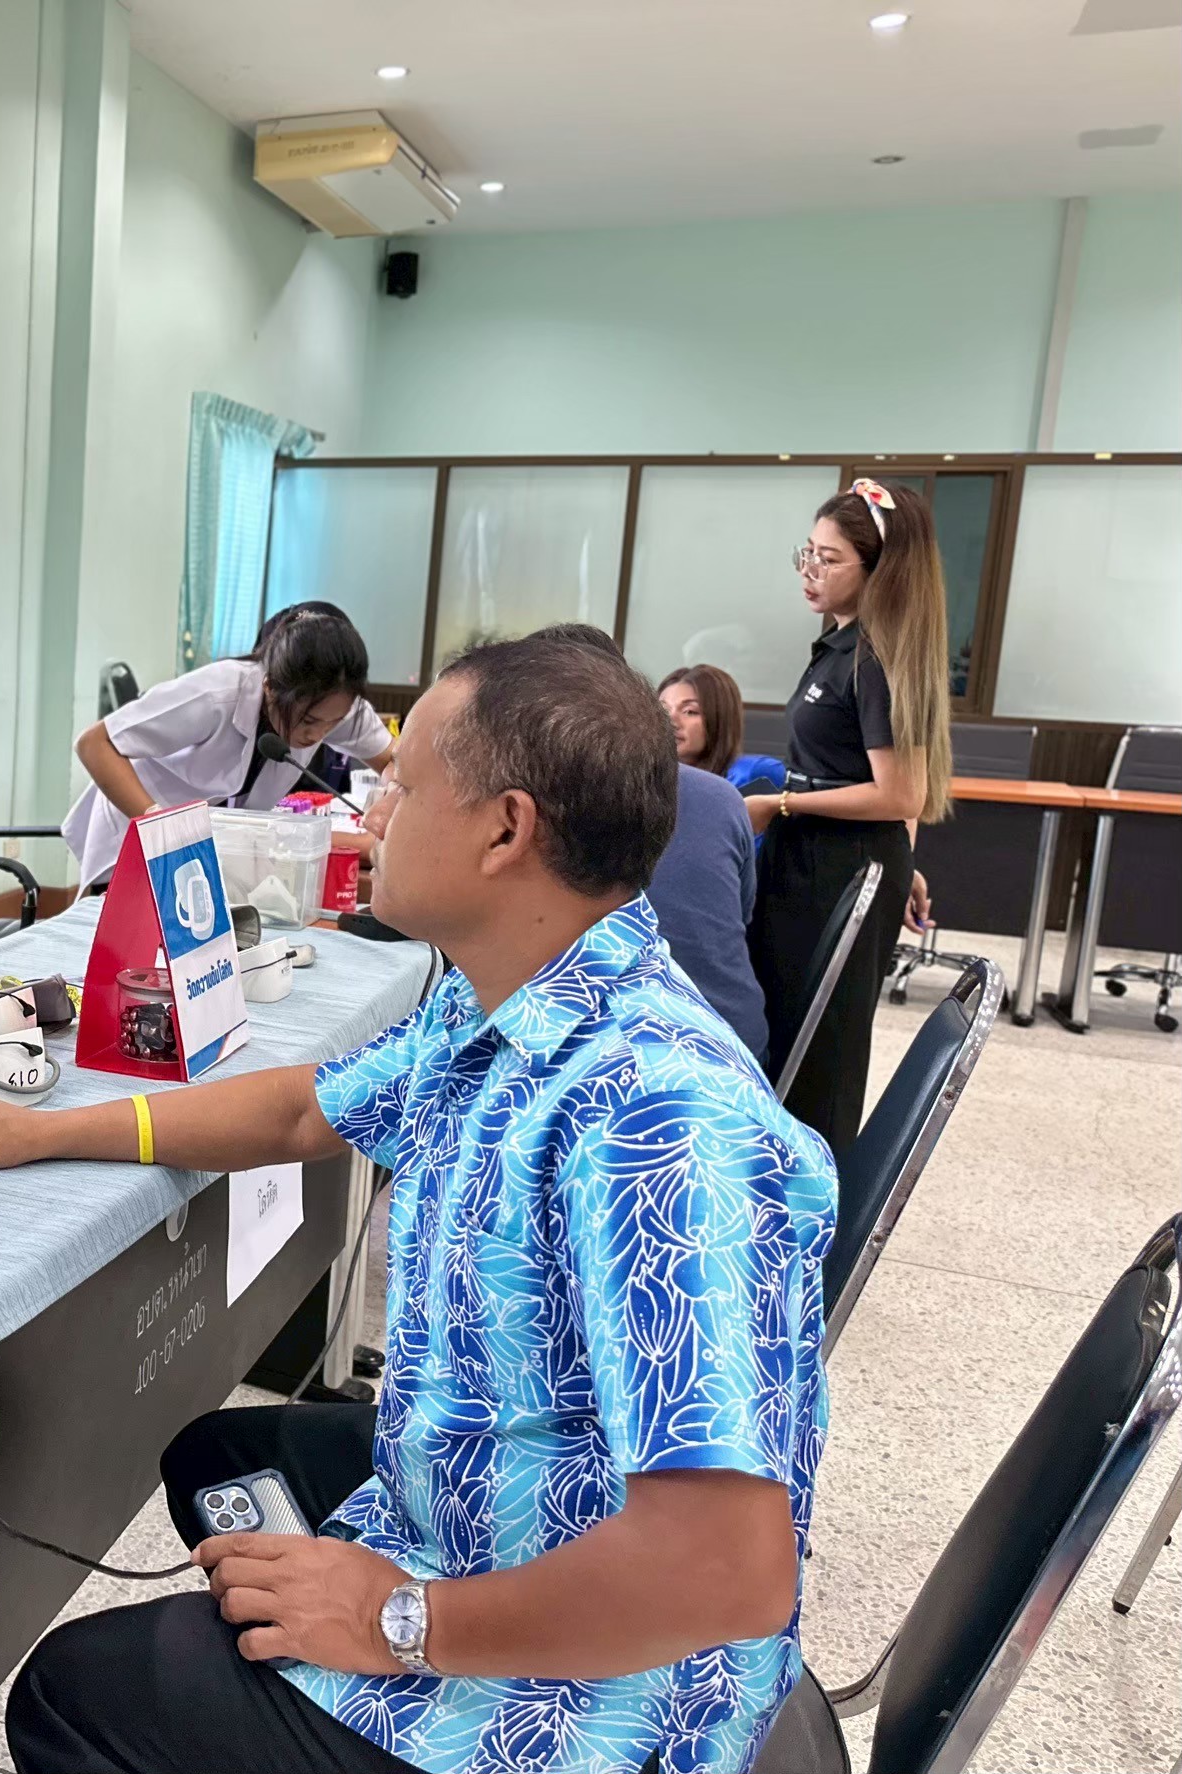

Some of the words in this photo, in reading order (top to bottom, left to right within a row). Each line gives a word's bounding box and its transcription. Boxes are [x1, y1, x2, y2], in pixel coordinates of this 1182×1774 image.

[186, 958, 234, 1000] วัดความดันโลหิต
